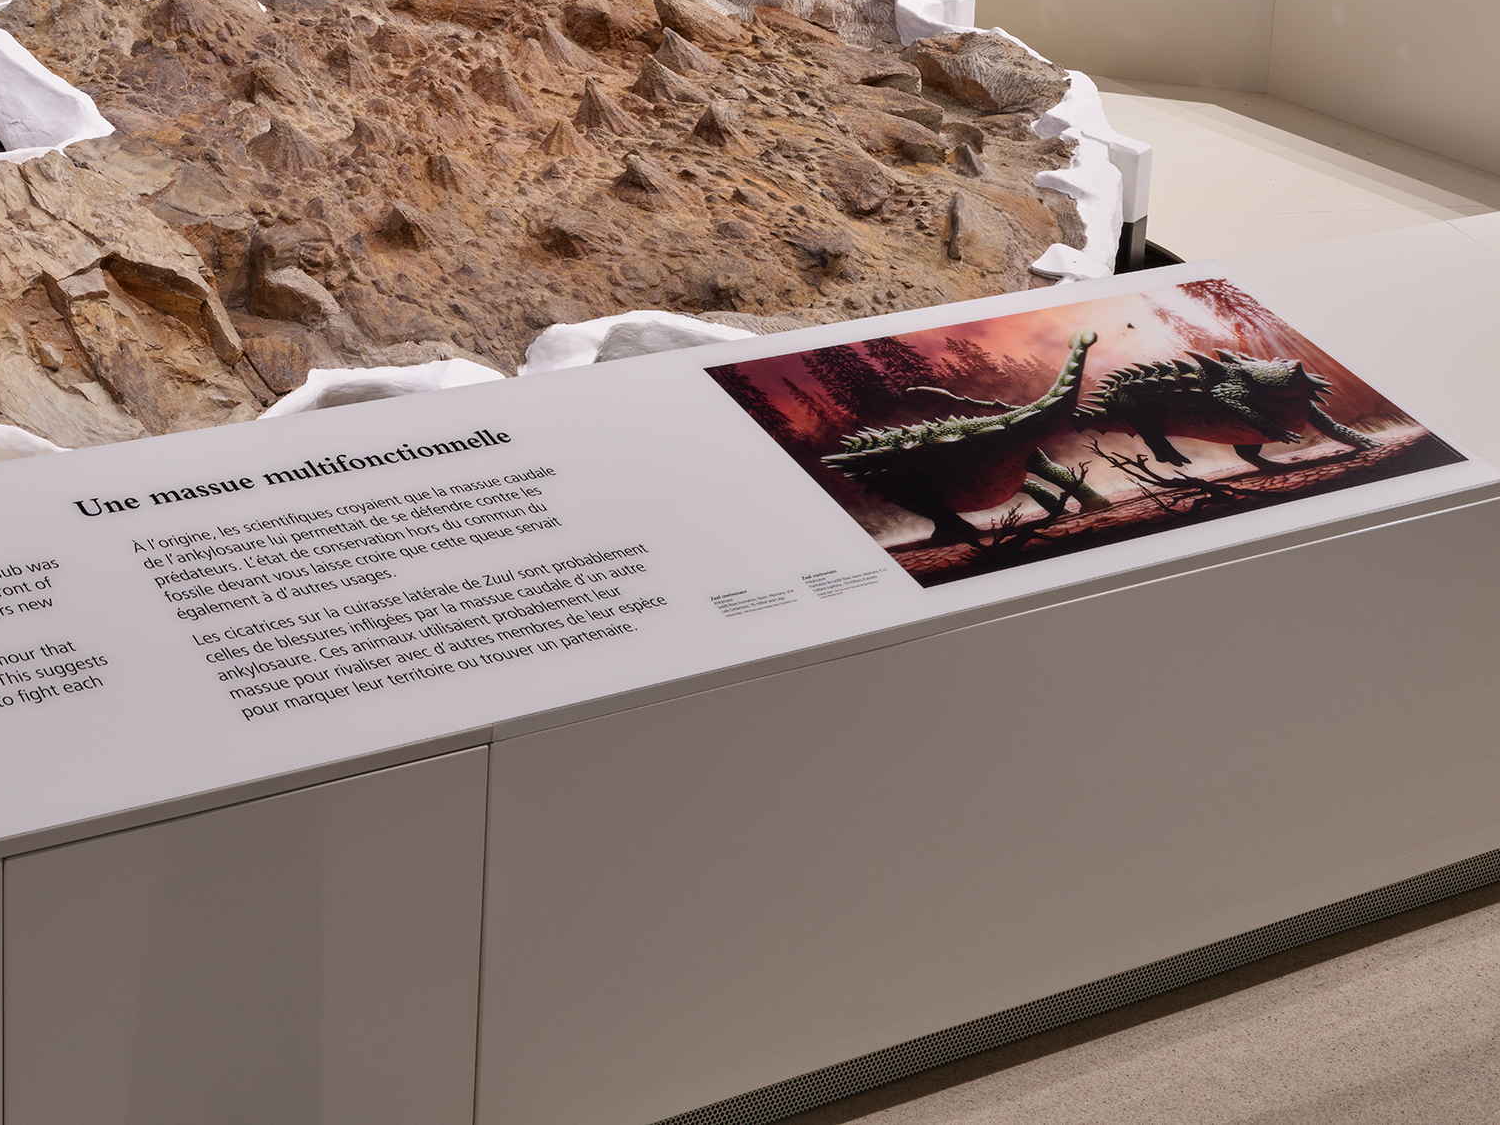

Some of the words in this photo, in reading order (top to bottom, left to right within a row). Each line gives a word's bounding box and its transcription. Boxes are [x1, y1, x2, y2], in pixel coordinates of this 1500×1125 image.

[73, 498, 140, 516] Une
[149, 478, 255, 505] massue
[262, 429, 511, 485] multifonctionnelle
[132, 538, 147, 553] À
[147, 532, 216, 550] l'origine,
[217, 526, 240, 537] les
[243, 509, 333, 532] scientifiques
[336, 496, 402, 515] croyaient
[404, 491, 432, 504] que
[431, 487, 448, 497] la
[449, 478, 502, 494] massue
[504, 467, 556, 484] caudale
[25, 560, 59, 572] was
[35, 576, 52, 590] of
[18, 598, 52, 612] new
[39, 641, 76, 657] that
[35, 656, 108, 678] suggests
[17, 685, 60, 704] fight
[63, 675, 103, 693] each
